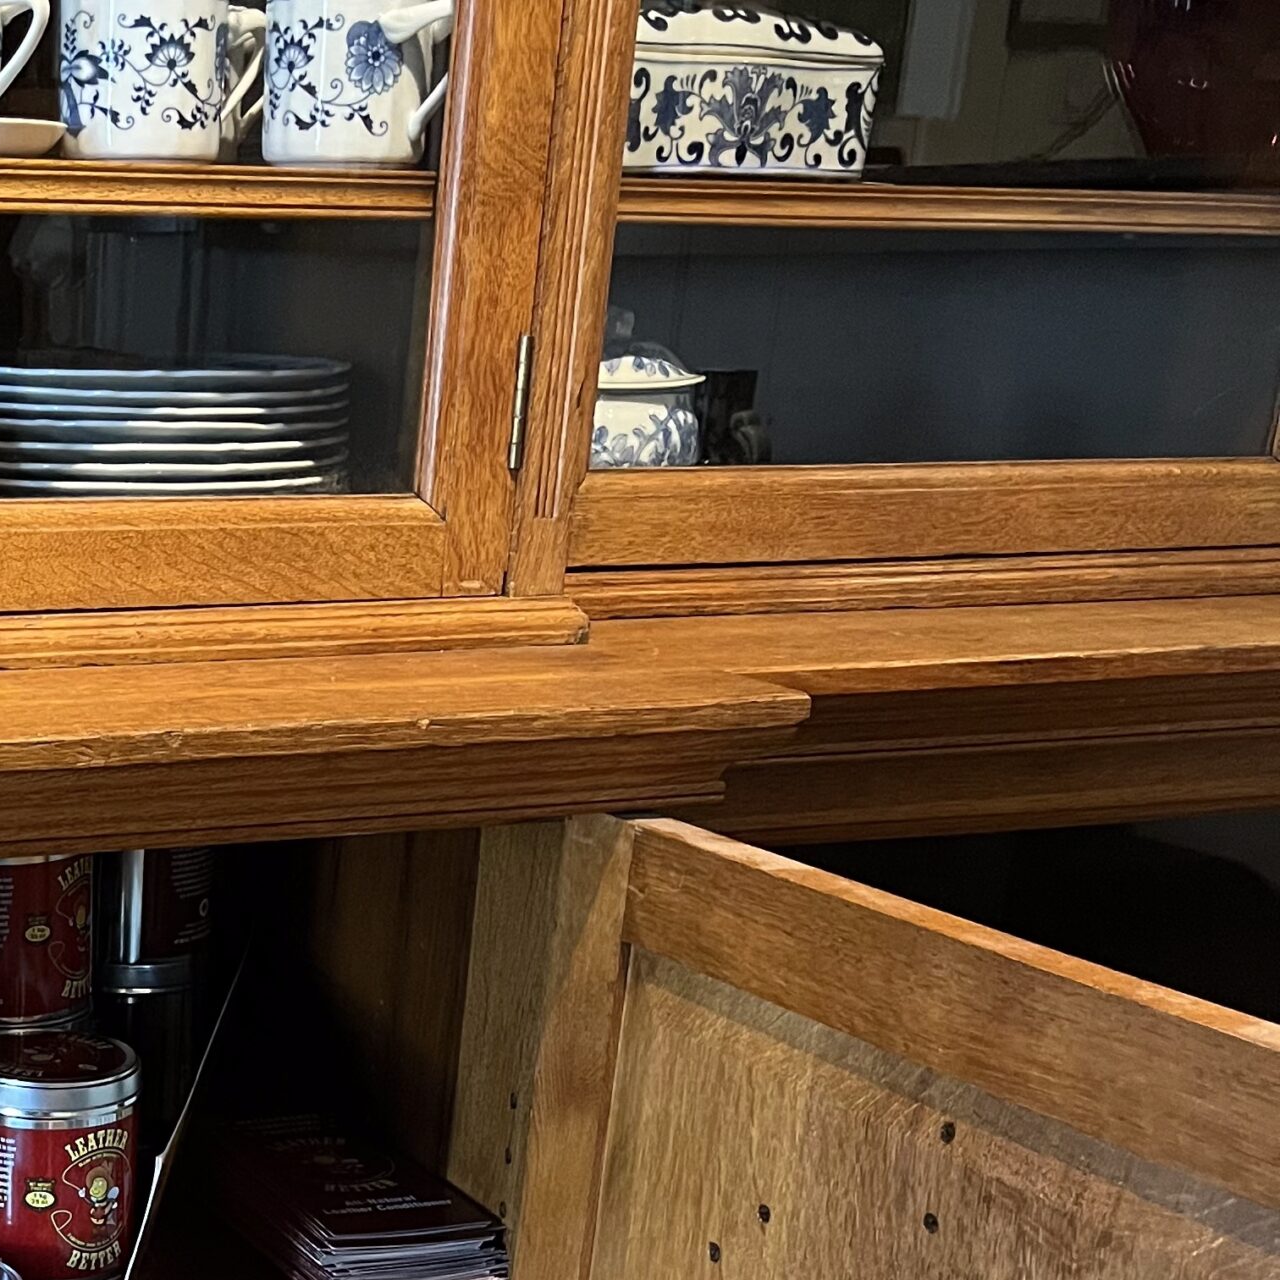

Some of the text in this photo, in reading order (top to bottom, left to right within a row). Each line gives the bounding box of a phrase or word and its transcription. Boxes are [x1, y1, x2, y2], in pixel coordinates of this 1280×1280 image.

[64, 1128, 129, 1162] LEATHER
[376, 1199, 453, 1211] Conditioner
[66, 1240, 122, 1270] BETTER
